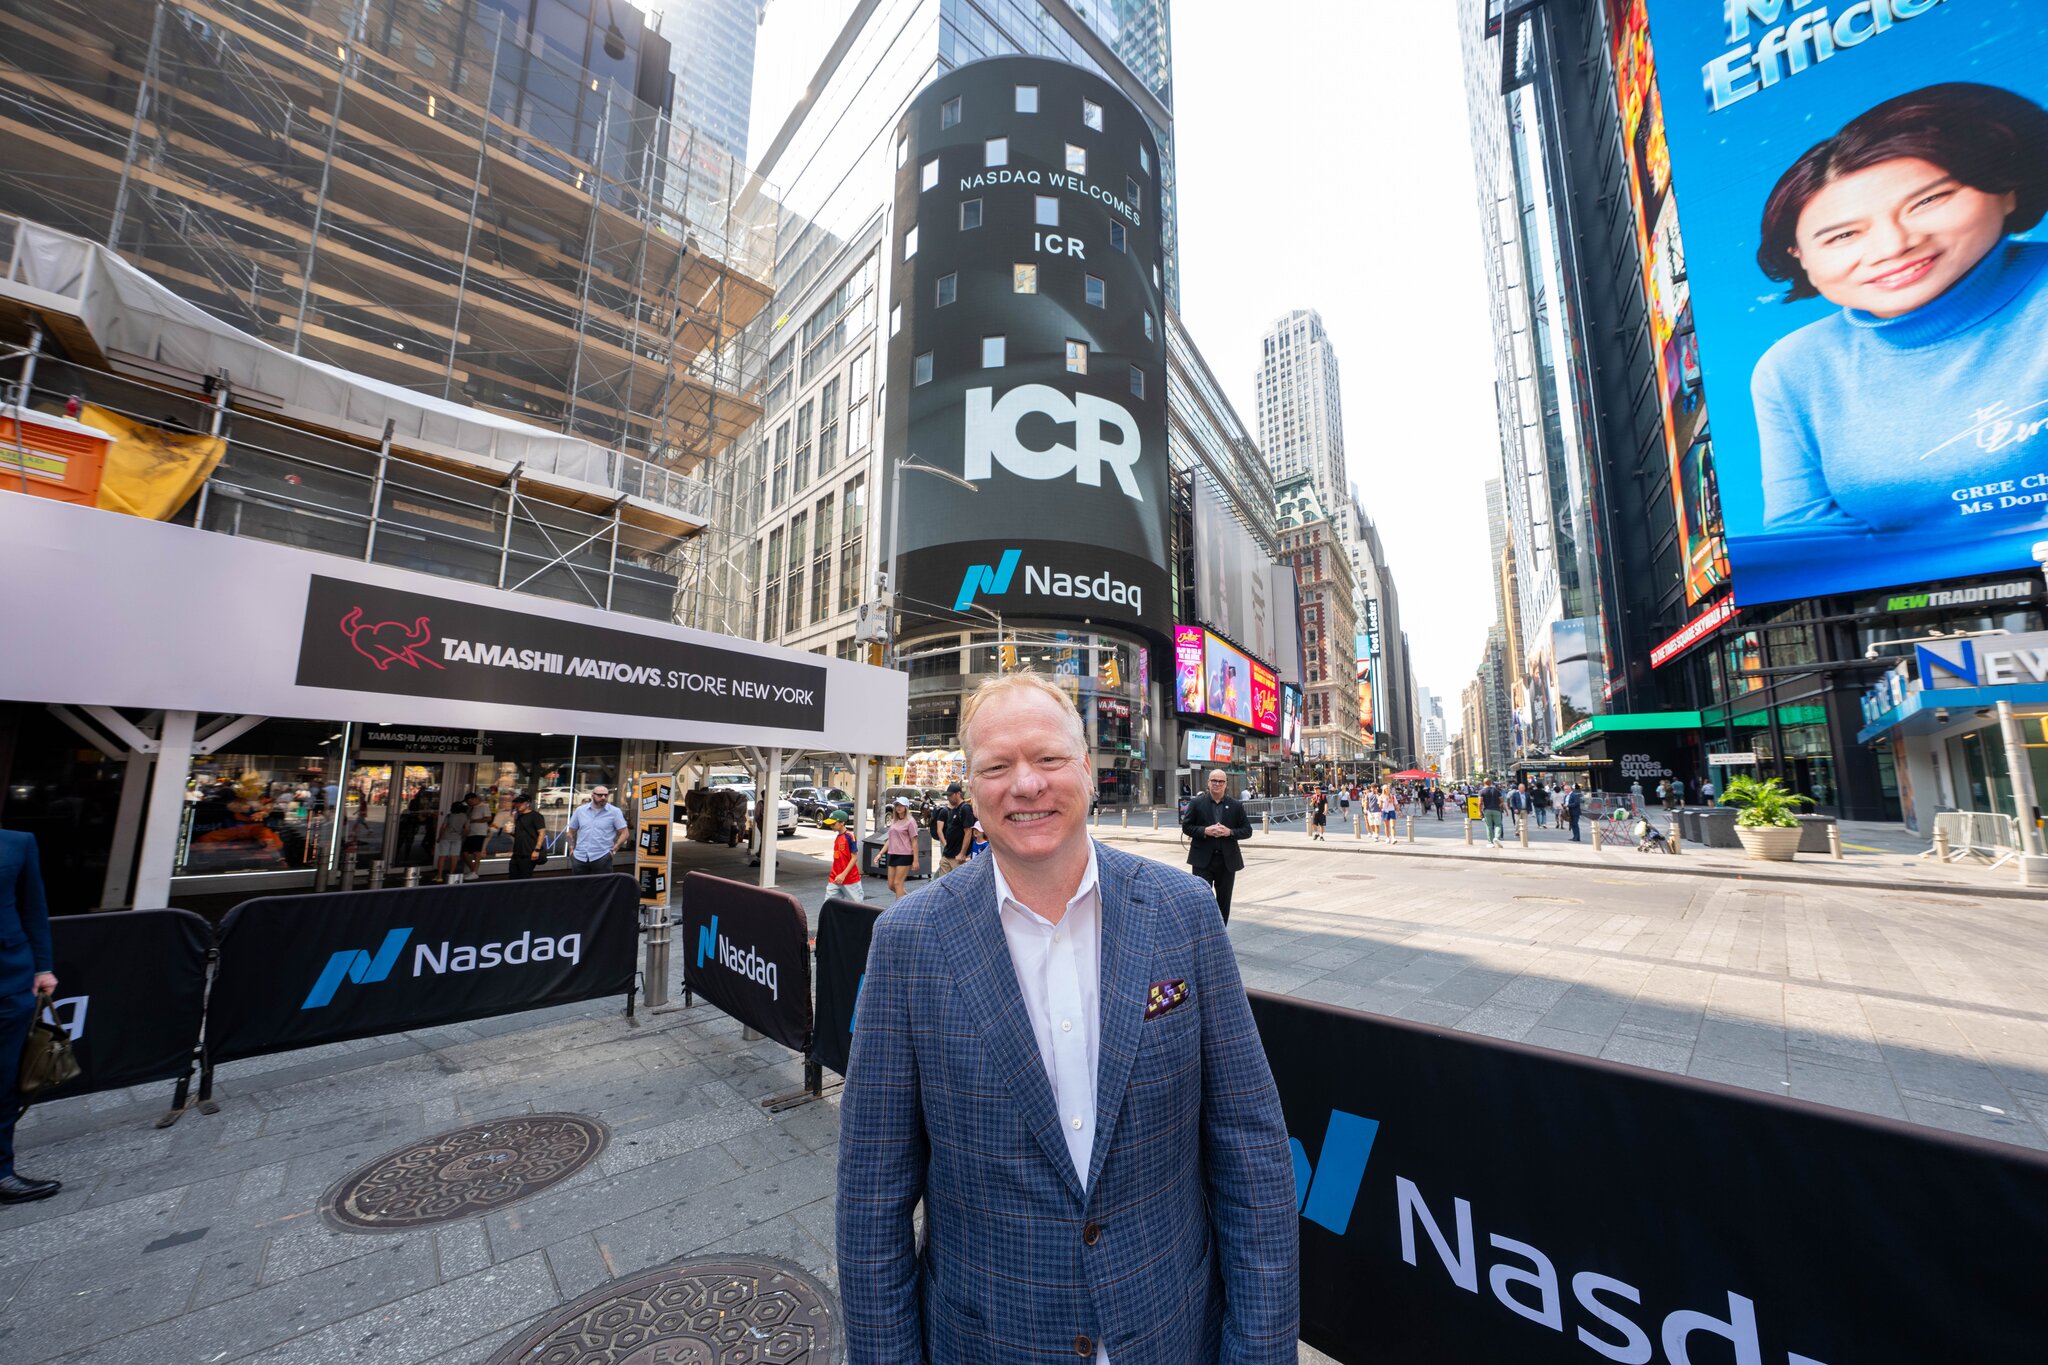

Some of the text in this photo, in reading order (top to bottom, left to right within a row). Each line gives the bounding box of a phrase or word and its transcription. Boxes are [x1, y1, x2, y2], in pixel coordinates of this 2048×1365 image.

[961, 170, 1141, 227] NASDAQ WELCOMES
[1034, 232, 1086, 260] ICR
[964, 384, 1143, 502] ICR
[1952, 480, 2016, 501] GREE
[1960, 501, 1994, 515] Ms
[1025, 564, 1142, 616] Nasdaq
[1368, 601, 1380, 653] Foot Locker
[441, 638, 814, 705] TAMASHII NATIONS STORE NEW YORK
[368, 732, 493, 746] TAMASHII NATIONS STORE
[1622, 754, 1650, 762] one
[1620, 758, 1661, 769] times
[1621, 768, 1672, 779] square
[413, 931, 581, 978] Nasdaq
[719, 933, 778, 1002] Nasdaq
[1396, 1175, 1829, 1365] Nasd
